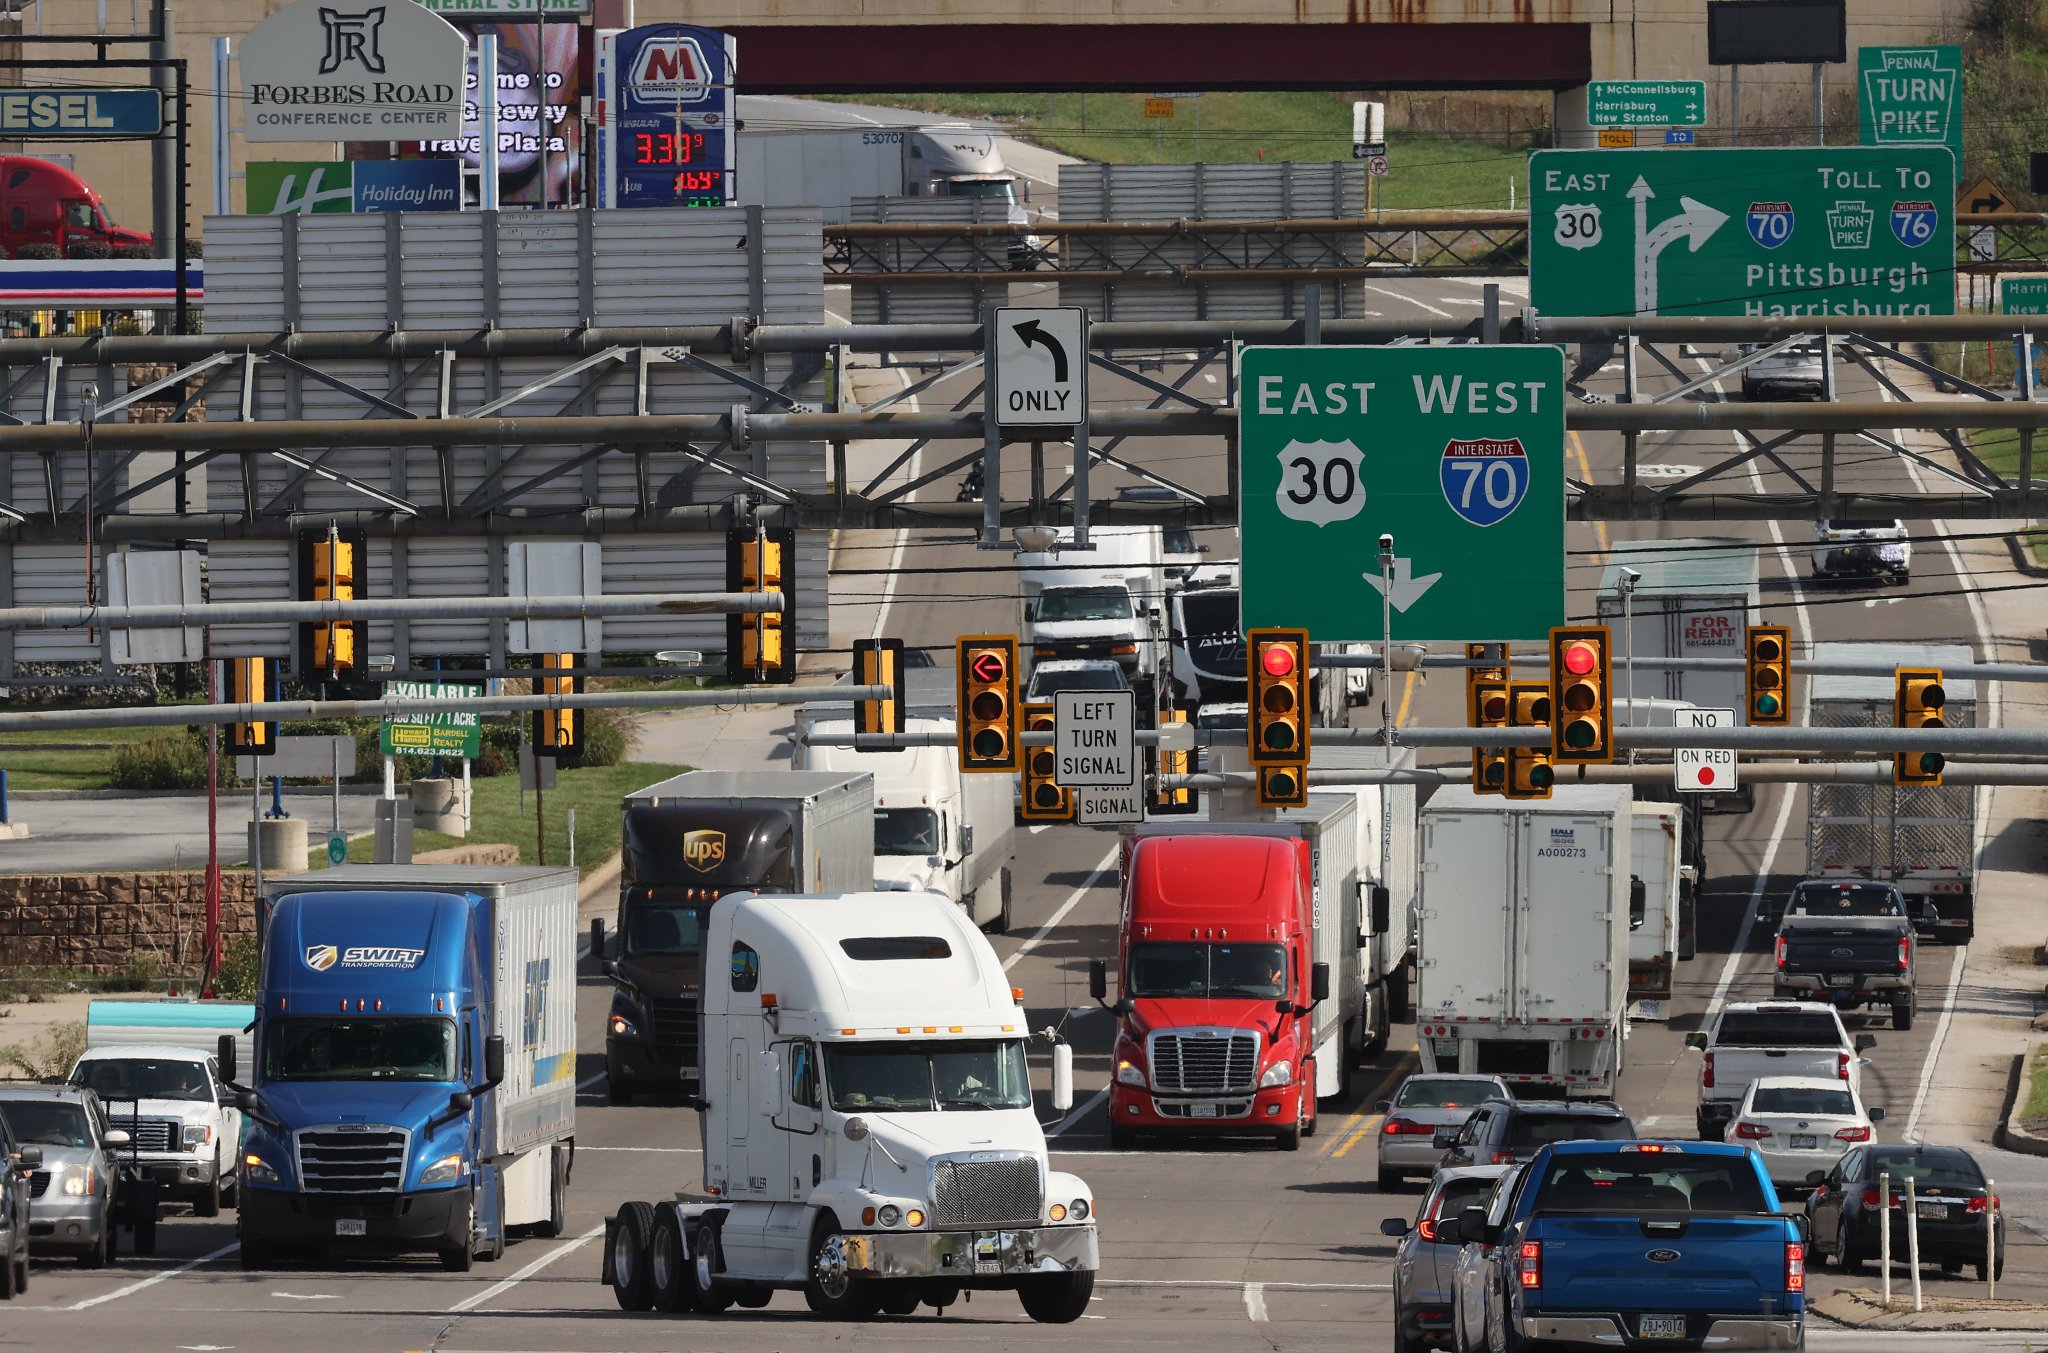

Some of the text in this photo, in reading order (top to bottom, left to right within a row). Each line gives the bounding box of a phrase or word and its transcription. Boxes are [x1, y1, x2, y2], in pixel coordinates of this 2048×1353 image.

[1887, 57, 1932, 69] PENNA
[251, 82, 454, 104] FORBES ROAD
[641, 82, 698, 92] MARATON
[1607, 85, 1696, 96] McConnellsburg
[1876, 78, 1945, 102] TURN
[0, 96, 113, 128] ESEL
[1595, 102, 1656, 112] Harrisburg
[257, 112, 447, 125] CONFERENCE CENTER
[1595, 113, 1669, 122] New Stanton
[1881, 110, 1940, 133] PIKE
[1603, 133, 1687, 143] TOLL TO
[1545, 170, 1610, 192] EAST
[1817, 167, 1931, 189] TOLL TO
[361, 183, 453, 205] Holiday Inn
[1560, 212, 1596, 239] 30
[1752, 213, 1788, 239] 70
[1831, 215, 1869, 228] TURN-
[1895, 212, 1930, 238] 76
[1836, 231, 1863, 244] PIKE
[1746, 262, 1928, 293] Pittsburgh
[2009, 304, 2039, 315] New
[1009, 390, 1071, 412] ONLY
[1258, 374, 1546, 414] EAST WEST
[1454, 443, 1515, 456] INTERSTATE
[1287, 456, 1355, 505] 30
[1451, 460, 1517, 509] 70
[1691, 616, 1728, 627] FOR
[1685, 627, 1735, 639] RENT
[1073, 703, 1115, 720] LEFT
[453, 712, 477, 726] ACRE
[1692, 714, 1717, 727] NO
[395, 729, 427, 738] Howard
[434, 729, 470, 737] BARDELL
[1072, 730, 1117, 747] TURN
[434, 739, 464, 747] REALTY
[396, 748, 465, 756] 814.623.8622
[1681, 750, 1731, 763] ON RED
[1063, 757, 1125, 774] SIGNAL
[1085, 799, 1137, 814] SIGNAL
[687, 842, 722, 864] ups
[1538, 848, 1586, 858] A000273
[342, 947, 425, 963] SWIFT
[749, 1176, 767, 1189] MILLER
